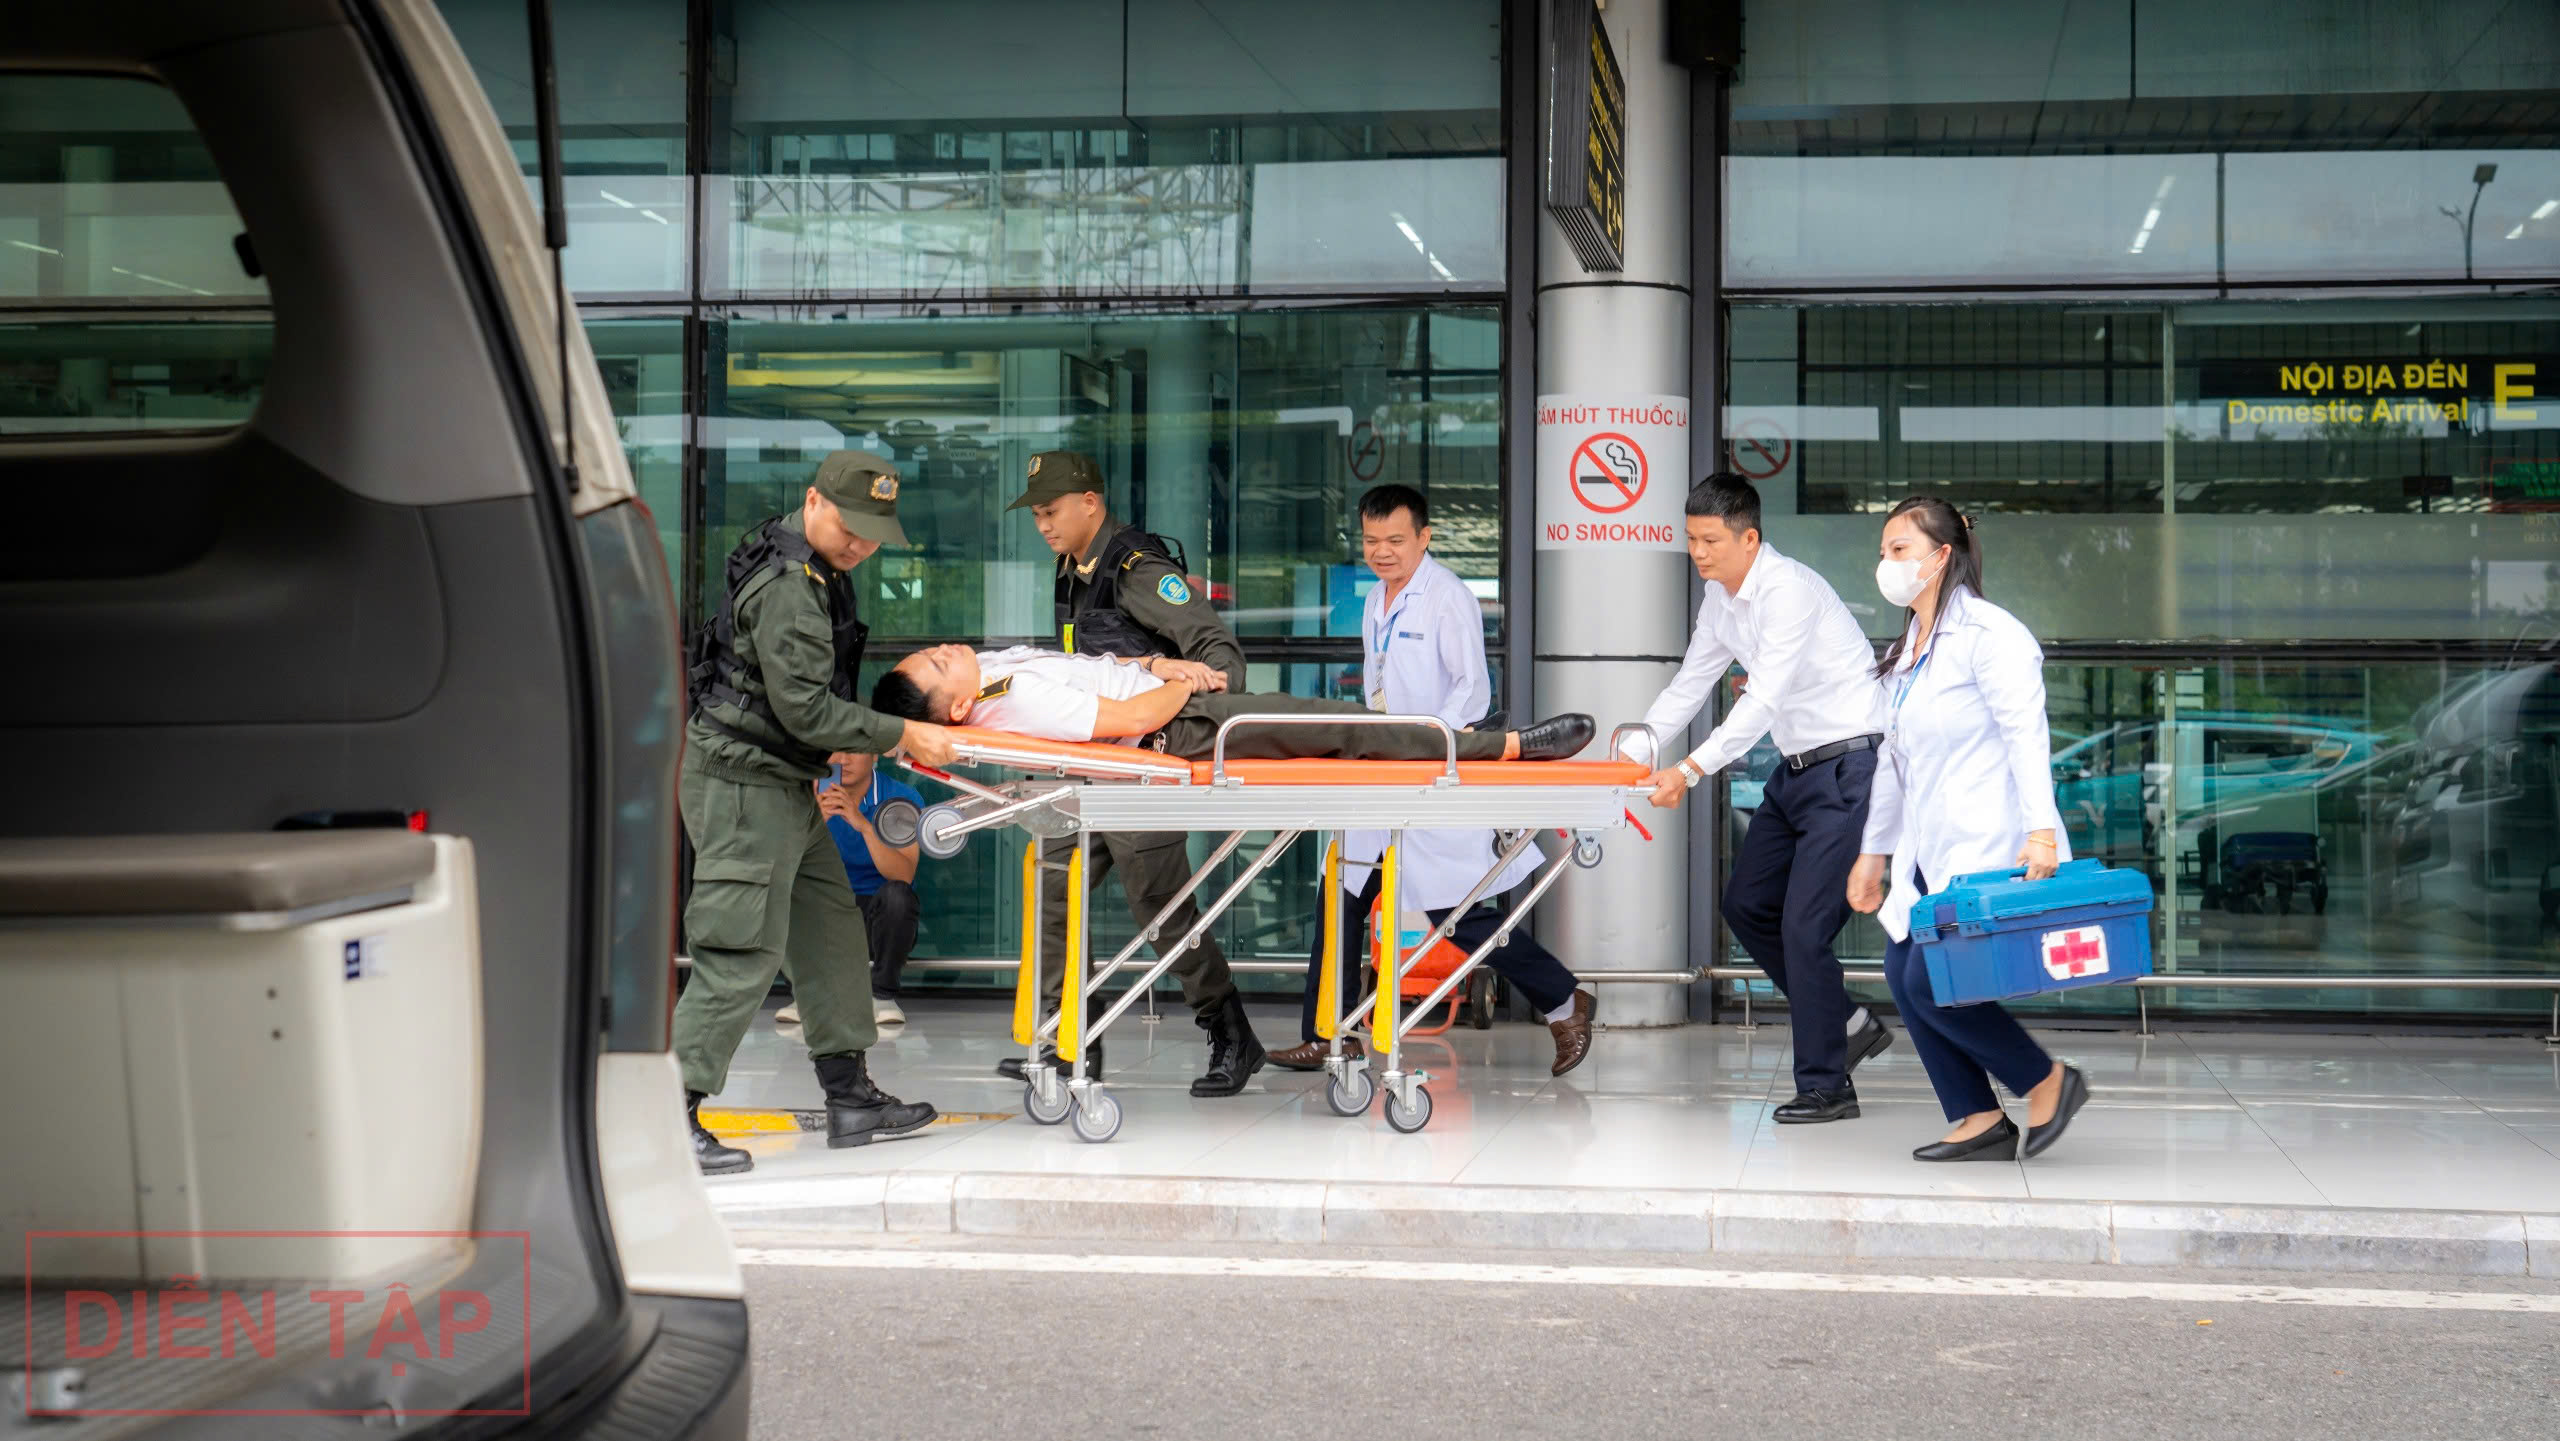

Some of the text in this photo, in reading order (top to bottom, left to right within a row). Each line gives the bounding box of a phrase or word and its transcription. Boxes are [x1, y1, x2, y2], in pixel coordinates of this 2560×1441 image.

[2280, 358, 2468, 395] NỘI ĐỊA ĐẾN
[2494, 363, 2537, 420] E
[1561, 403, 1601, 425] HÚT
[1606, 402, 1673, 426] THUỐC
[2228, 397, 2468, 424] Domestic Arrival
[1547, 523, 1674, 543] NO SMOKING
